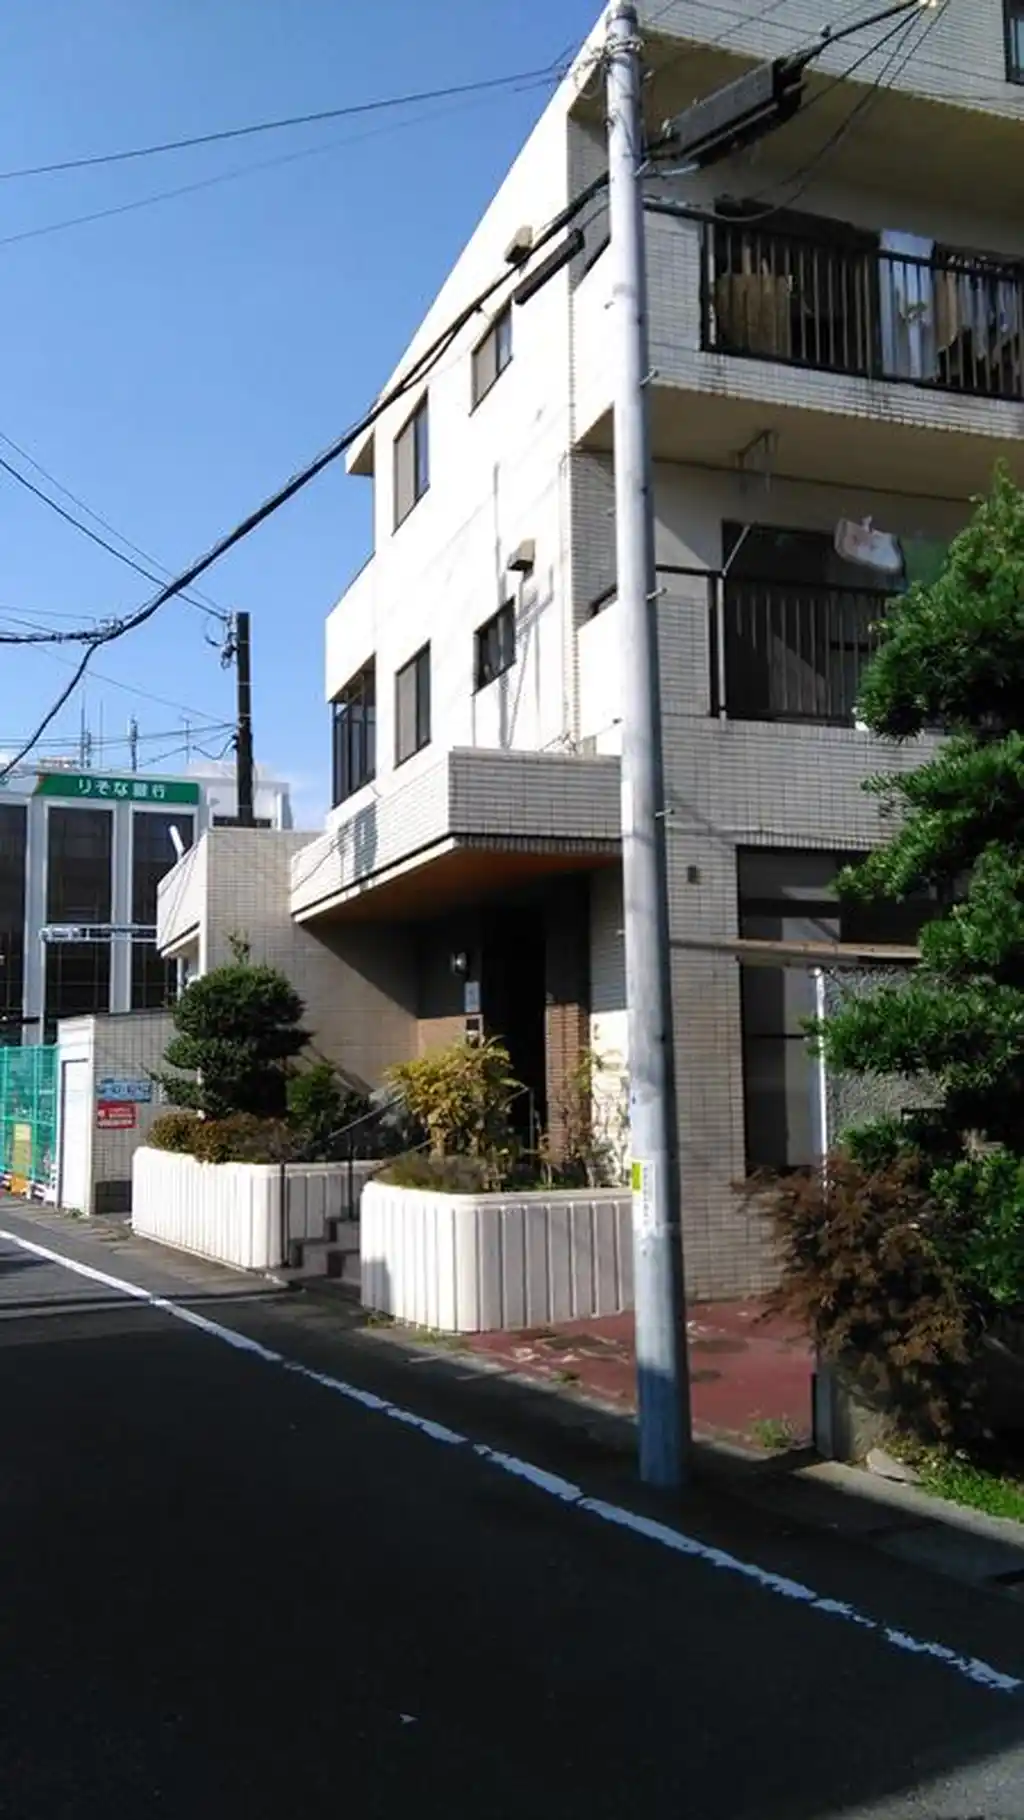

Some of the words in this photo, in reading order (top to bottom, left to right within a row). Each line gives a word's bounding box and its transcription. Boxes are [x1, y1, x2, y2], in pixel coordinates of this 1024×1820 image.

[78, 779, 166, 799] りそな銀行
